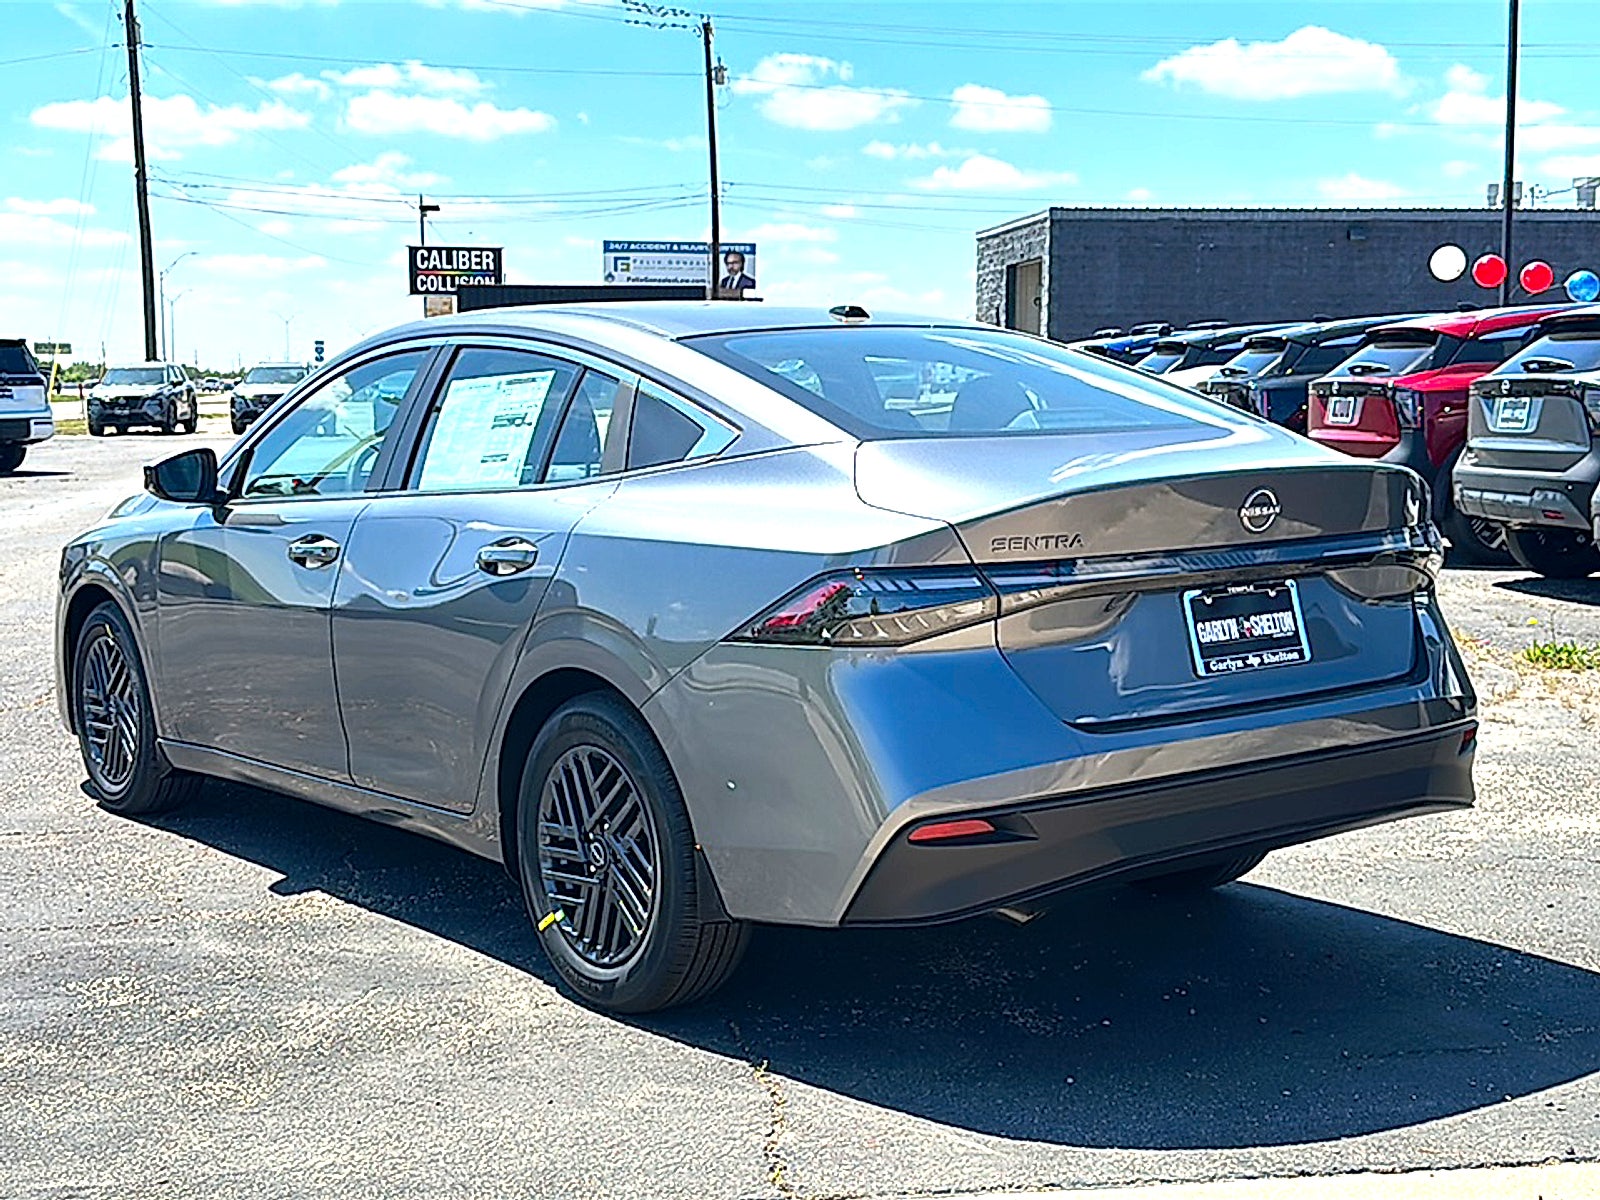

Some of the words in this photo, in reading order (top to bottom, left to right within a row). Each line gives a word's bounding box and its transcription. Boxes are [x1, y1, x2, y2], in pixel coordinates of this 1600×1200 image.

[630, 243, 671, 251] ACCIDENT
[416, 249, 495, 270] CALIBER
[416, 275, 495, 291] COLLISION
[1240, 505, 1281, 518] NISSAN
[991, 533, 1084, 552] SENTRA
[1249, 610, 1296, 636] SHELTON
[1262, 651, 1300, 664] Shelton
